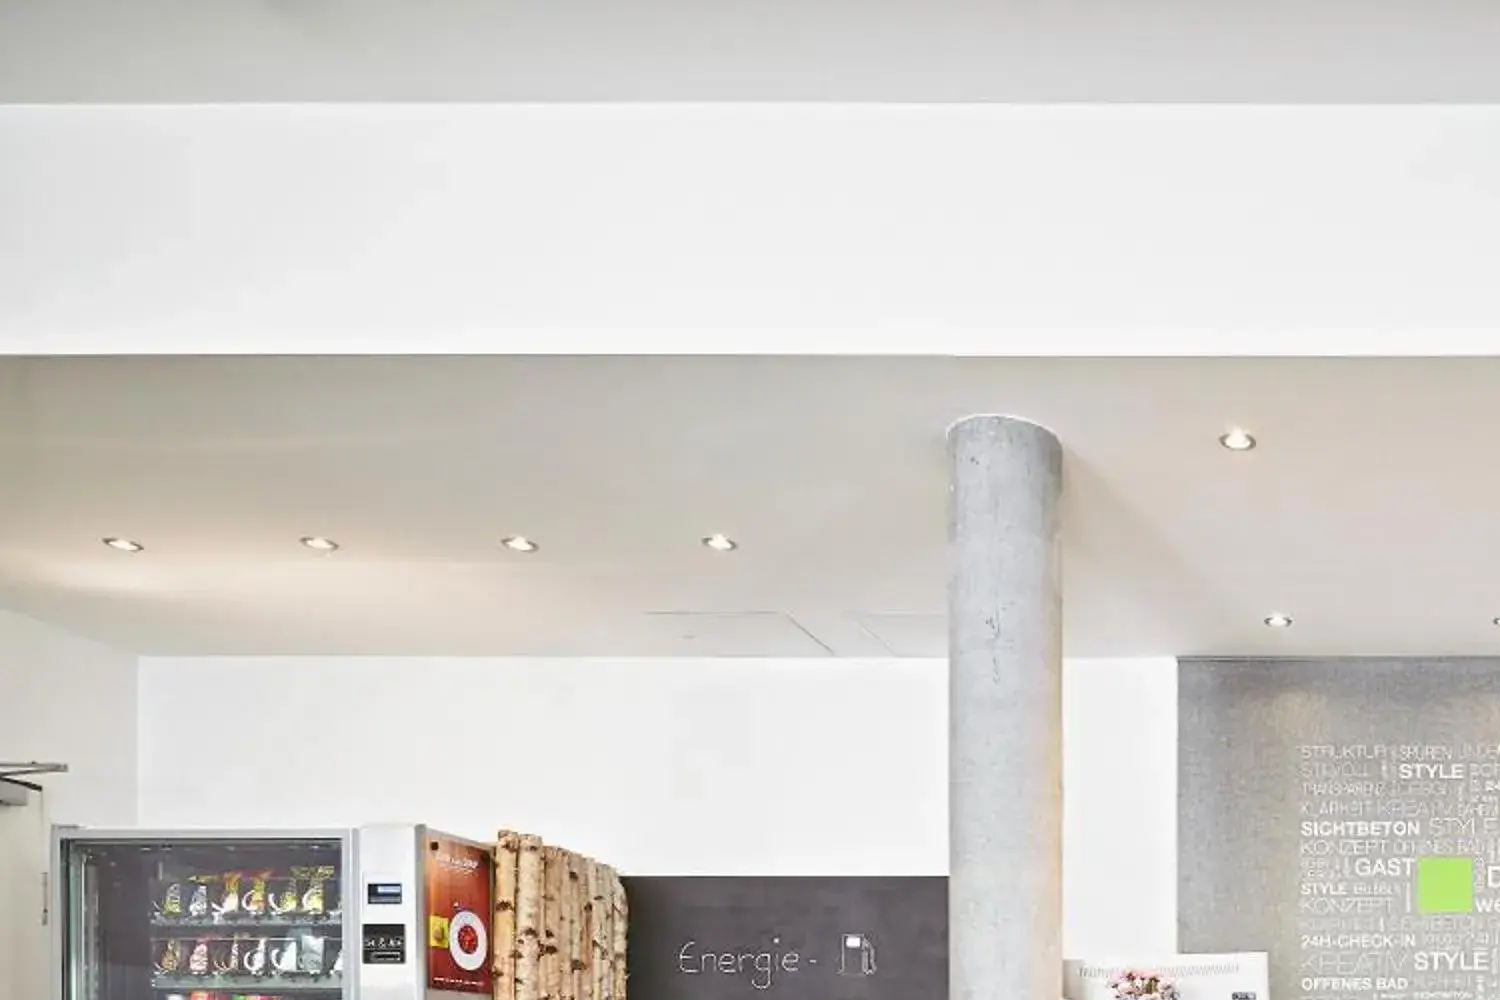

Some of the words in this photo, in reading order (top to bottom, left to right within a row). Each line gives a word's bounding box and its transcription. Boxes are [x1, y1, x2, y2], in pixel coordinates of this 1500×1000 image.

[1399, 763, 1465, 780] STYLE
[1300, 820, 1420, 837] SICHTBETON
[1355, 857, 1416, 877] GAST
[1300, 882, 1348, 896] STYLE
[1300, 934, 1416, 951] 24H-CHECK-IN
[1414, 951, 1490, 972] STYLE
[1300, 977, 1372, 991] OFFENES
[1376, 977, 1409, 991] BAD
